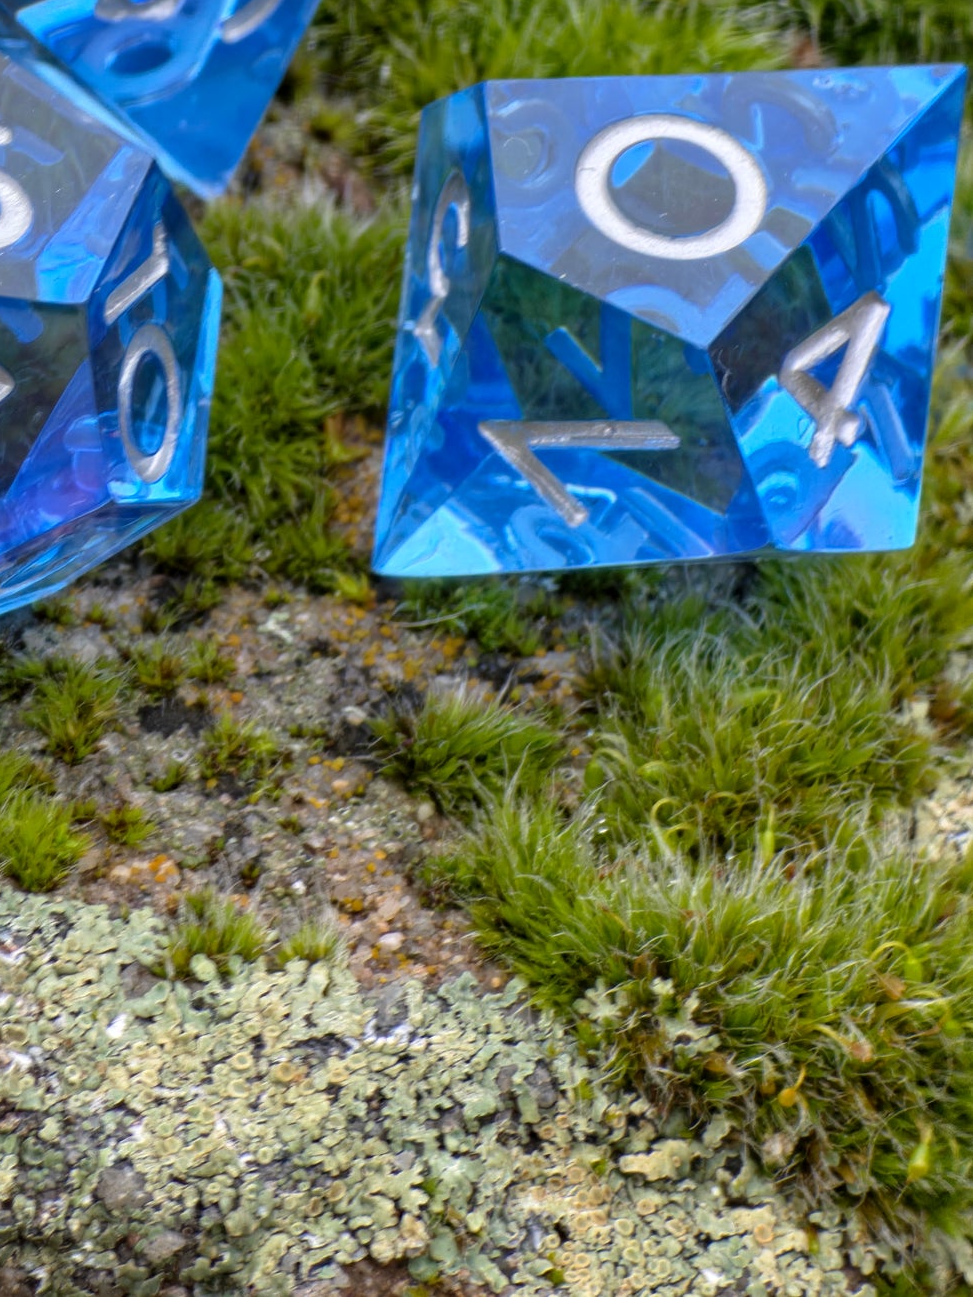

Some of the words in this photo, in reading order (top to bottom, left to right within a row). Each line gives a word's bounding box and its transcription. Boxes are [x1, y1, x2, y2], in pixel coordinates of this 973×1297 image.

[575, 113, 769, 262] 0
[102, 222, 183, 484] 10
[778, 290, 891, 469] 4
